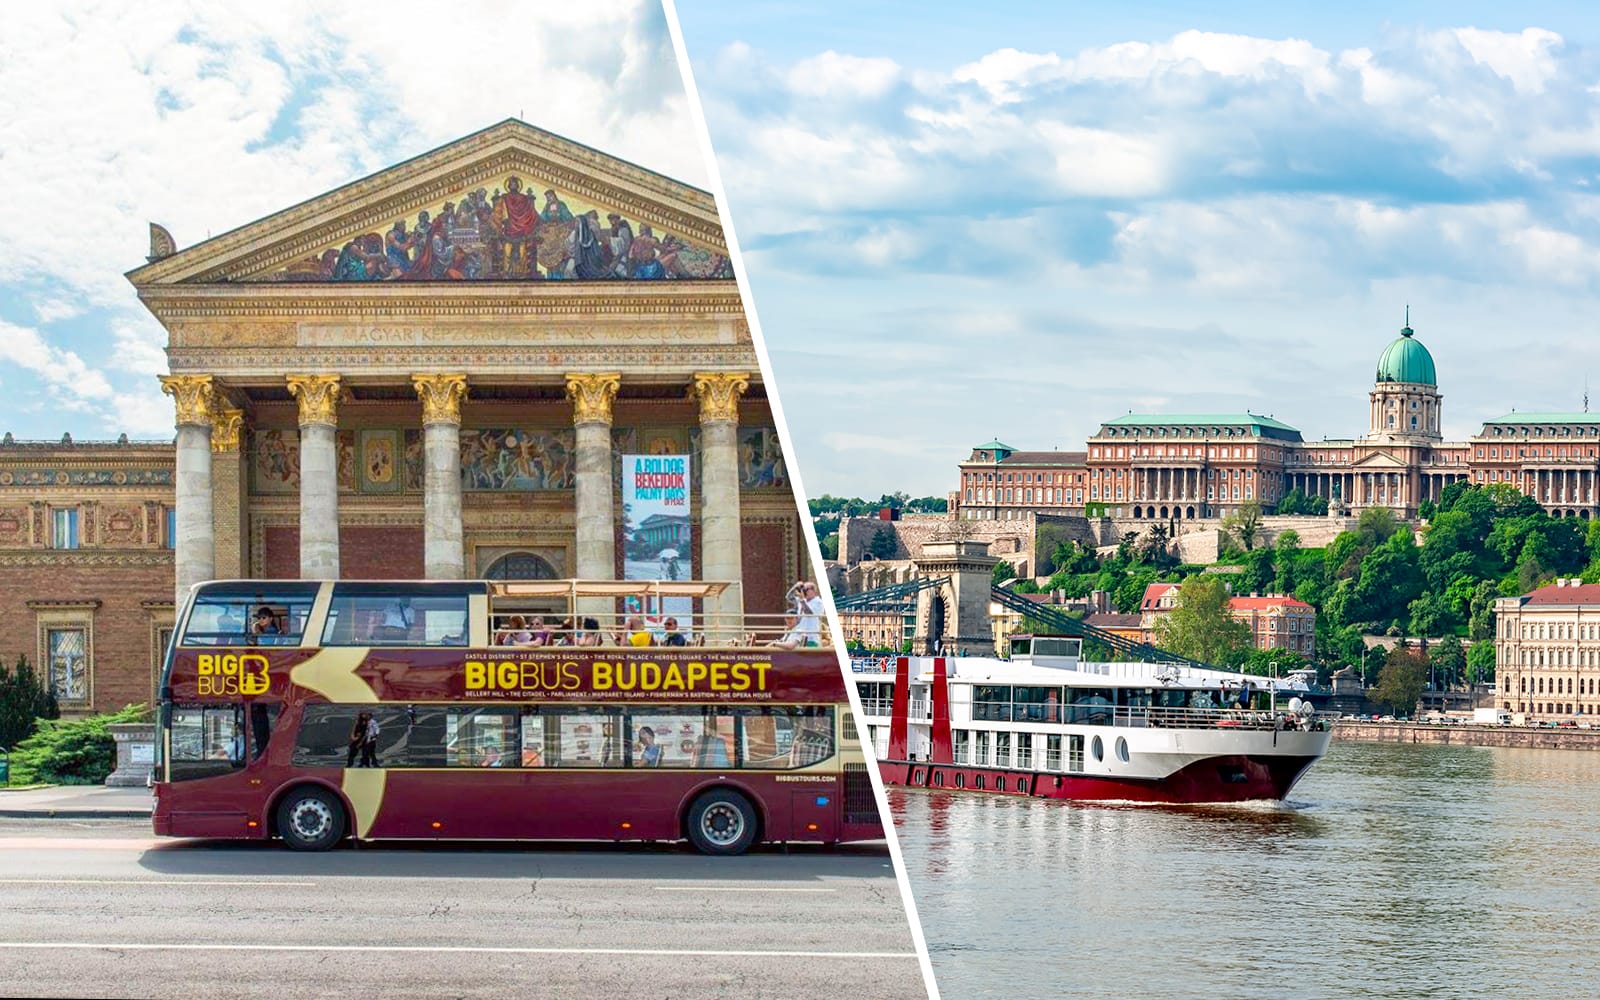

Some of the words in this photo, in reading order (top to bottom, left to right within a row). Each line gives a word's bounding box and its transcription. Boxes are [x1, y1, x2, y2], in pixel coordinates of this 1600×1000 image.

[343, 328, 413, 342] MAGYAR
[635, 458, 642, 473] A
[644, 458, 684, 473] BOLDOG
[635, 488, 662, 499] PALMY
[664, 488, 685, 499] DAYS
[198, 655, 238, 675] BIG
[592, 662, 772, 690] BUDAPEST
[198, 677, 238, 695] BUS
